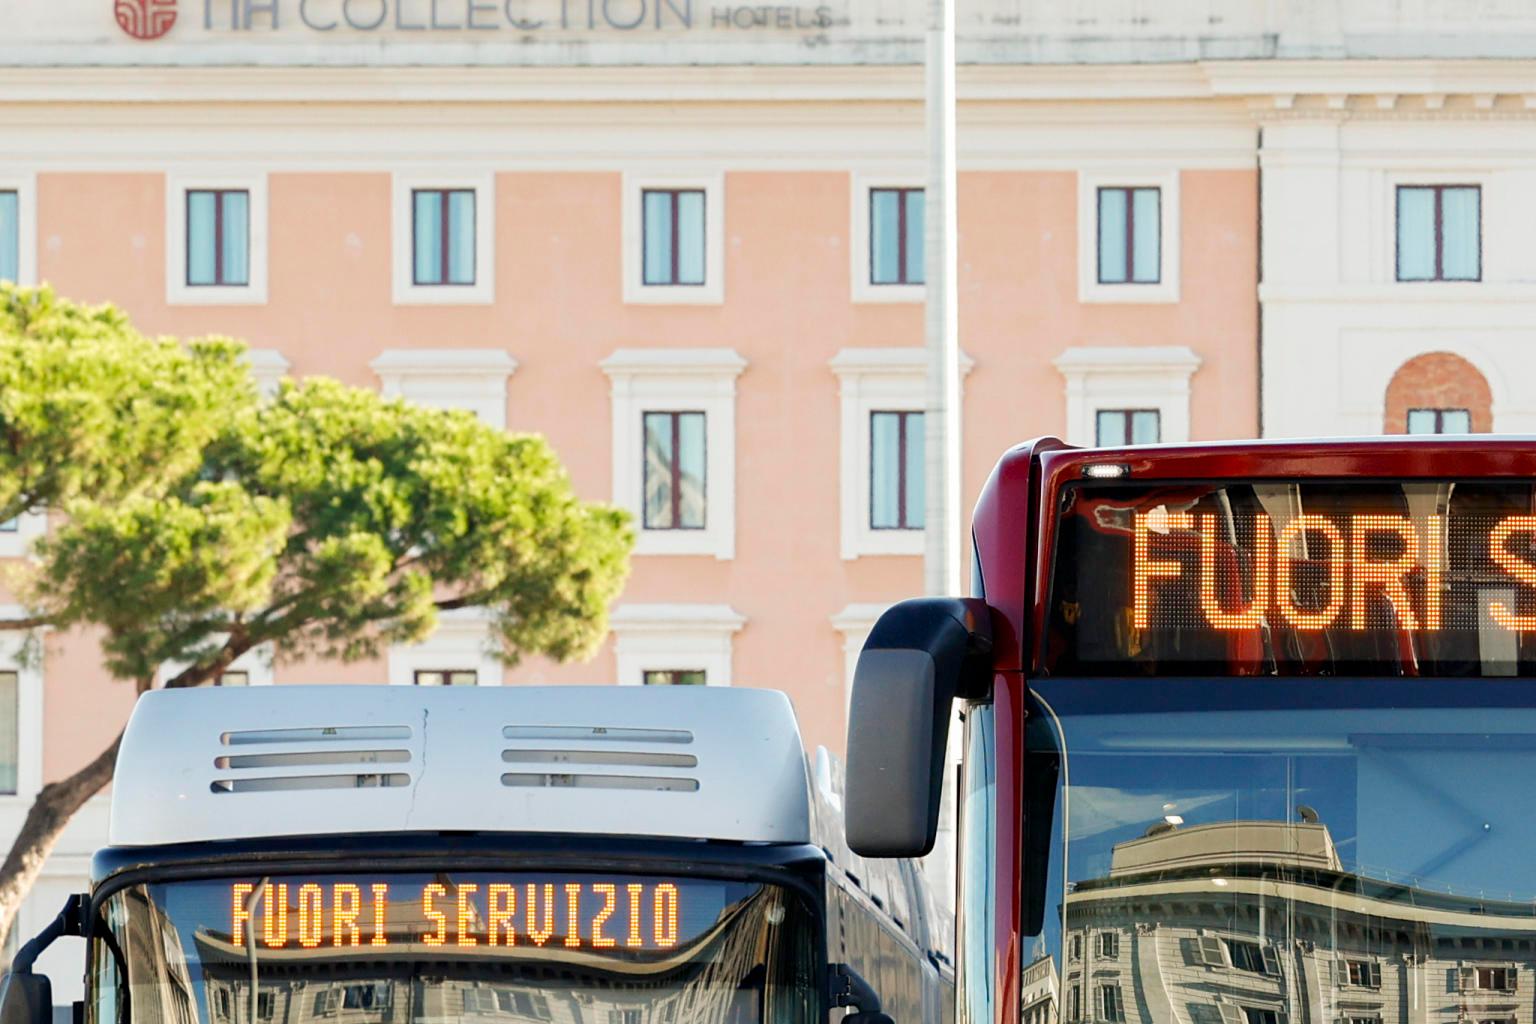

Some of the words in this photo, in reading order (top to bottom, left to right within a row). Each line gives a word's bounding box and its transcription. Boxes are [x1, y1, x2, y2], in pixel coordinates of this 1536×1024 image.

[299, 0, 693, 31] COLLECTION
[710, 6, 835, 30] HOTELS
[1133, 513, 1441, 632] FUORI
[231, 882, 390, 948] FUORI
[422, 882, 679, 949] SERVIZIO
